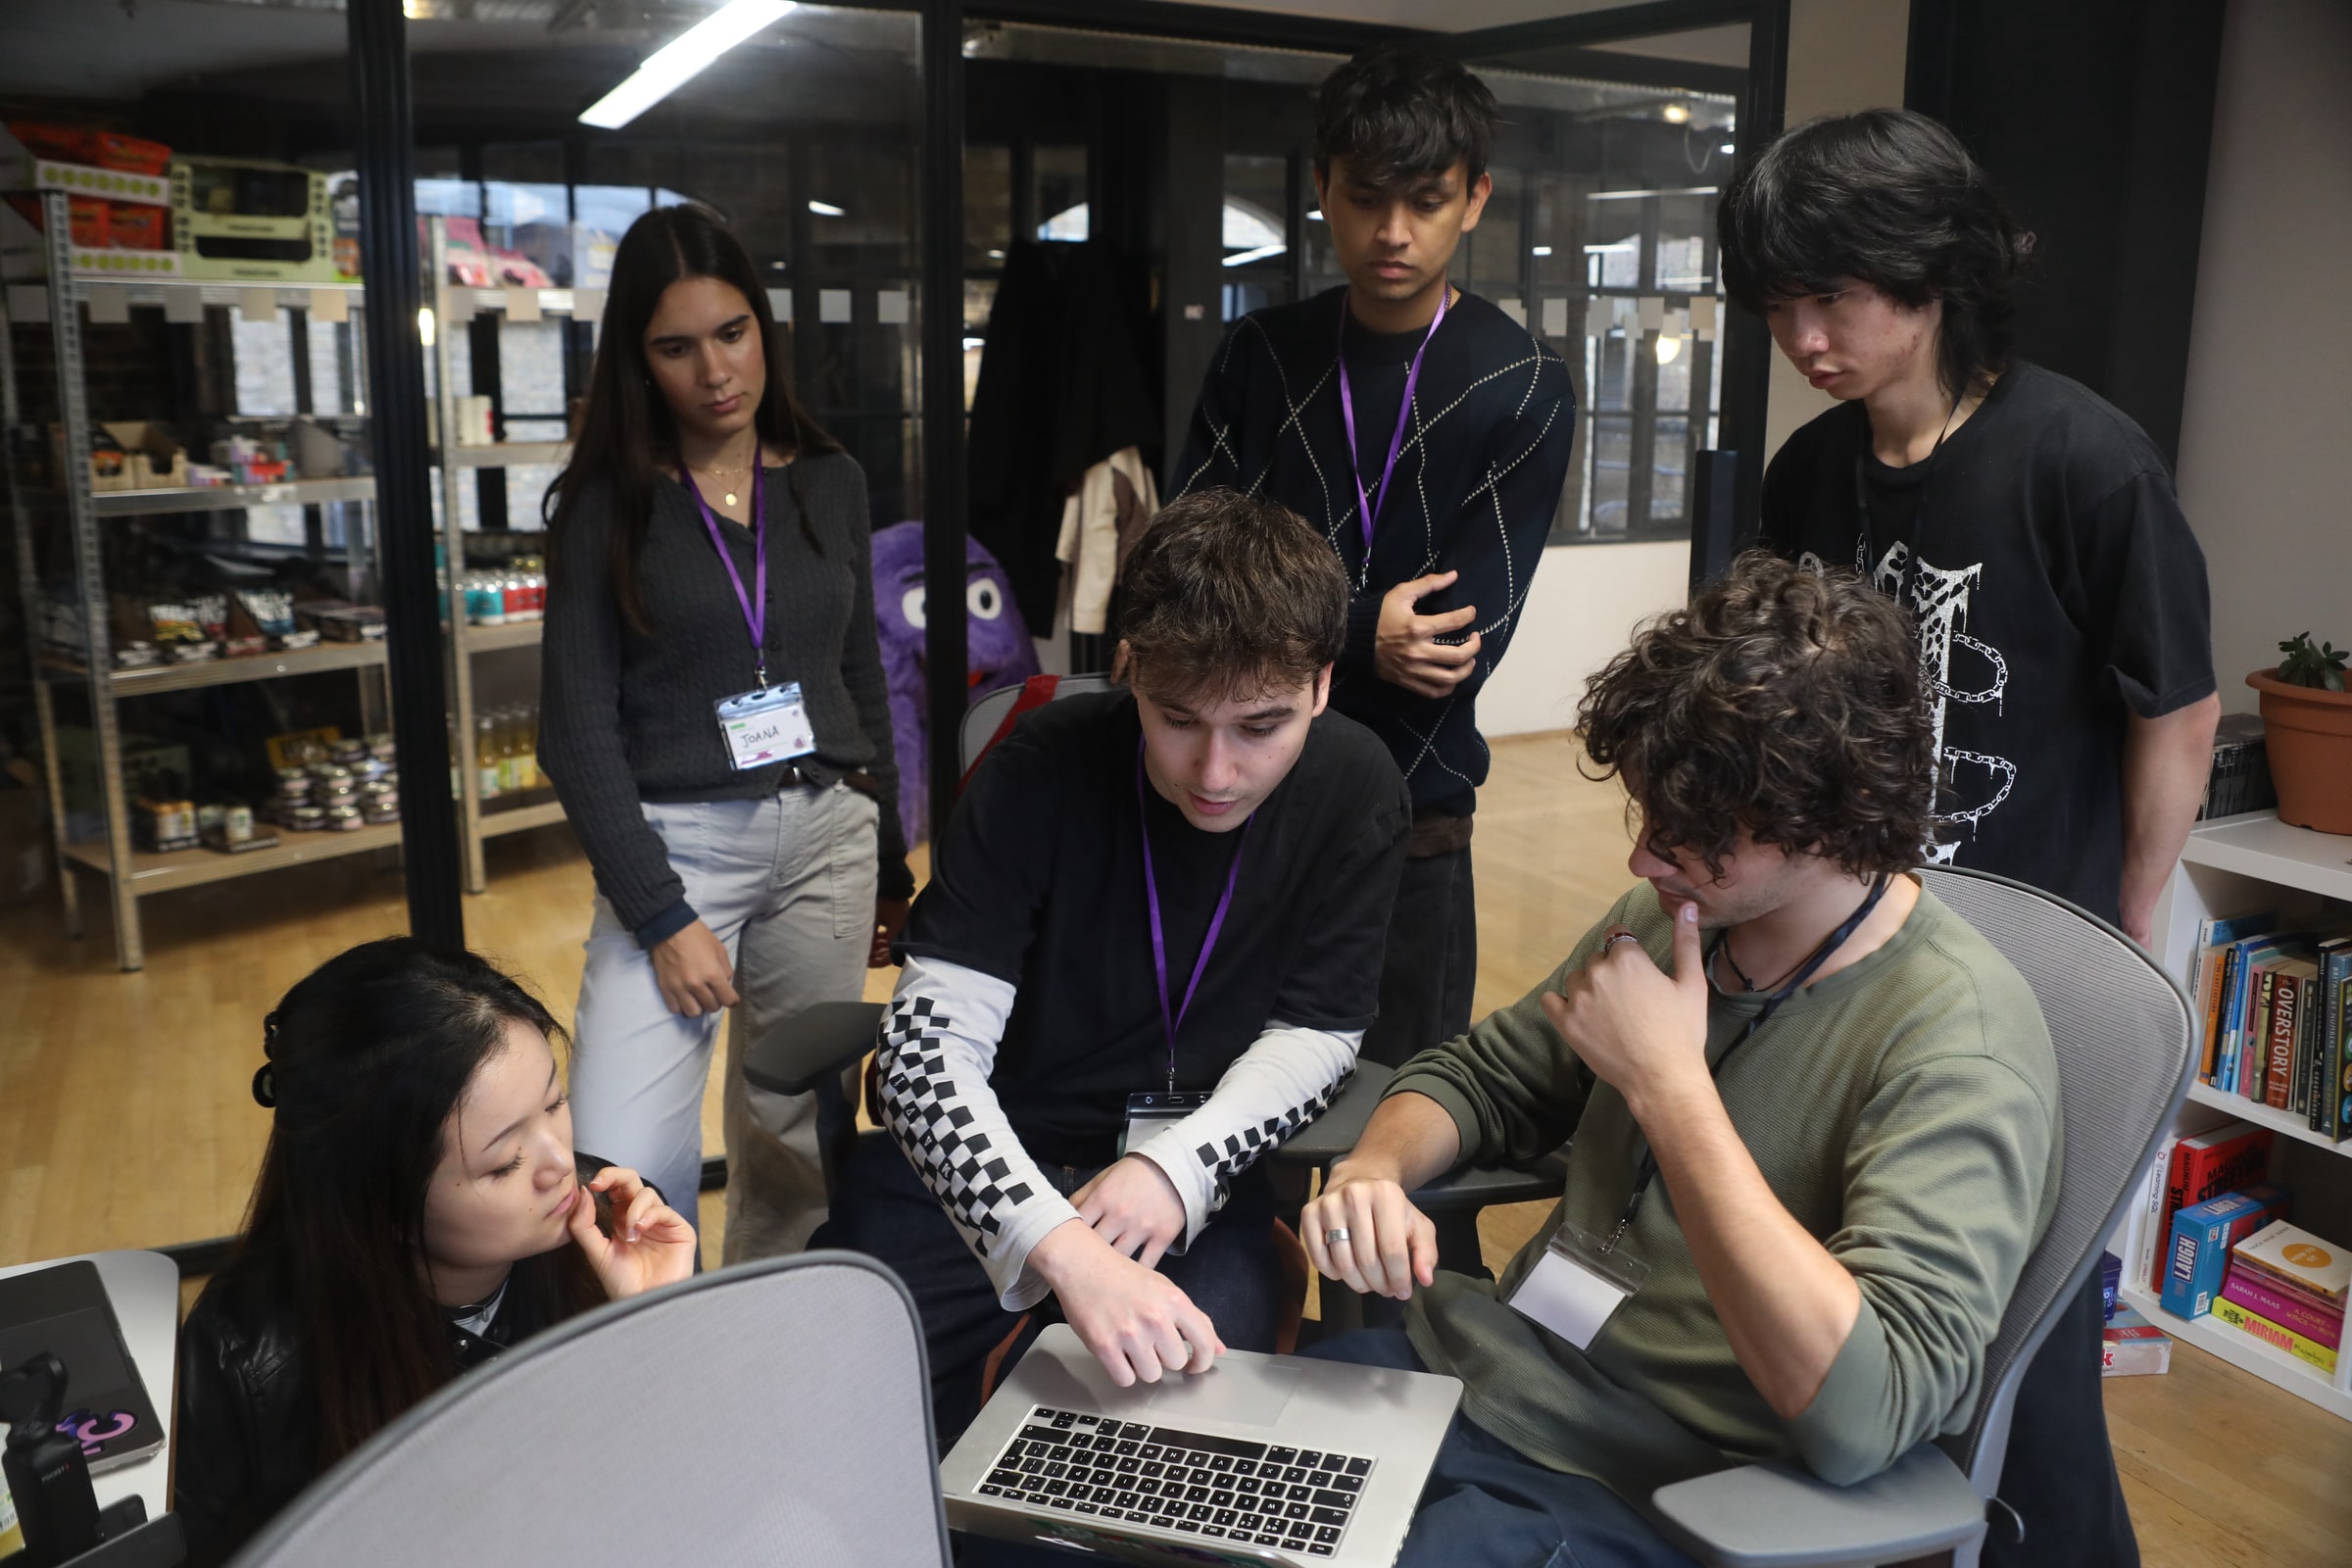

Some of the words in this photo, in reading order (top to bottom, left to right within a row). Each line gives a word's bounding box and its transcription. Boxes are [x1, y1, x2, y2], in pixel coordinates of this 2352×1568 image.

[740, 725, 780, 748] JOANA
[2331, 1000, 2337, 1010] BY
[2272, 987, 2294, 1078] OVERSTORY
[2328, 1013, 2337, 1050] NUMBERS
[2152, 1170, 2162, 1199] Learning
[2174, 1236, 2196, 1281] LAUGH
[2230, 1283, 2253, 1296] SARAH
[2259, 1297, 2280, 1310] MAAS
[2244, 1316, 2294, 1351] MIRIAM
